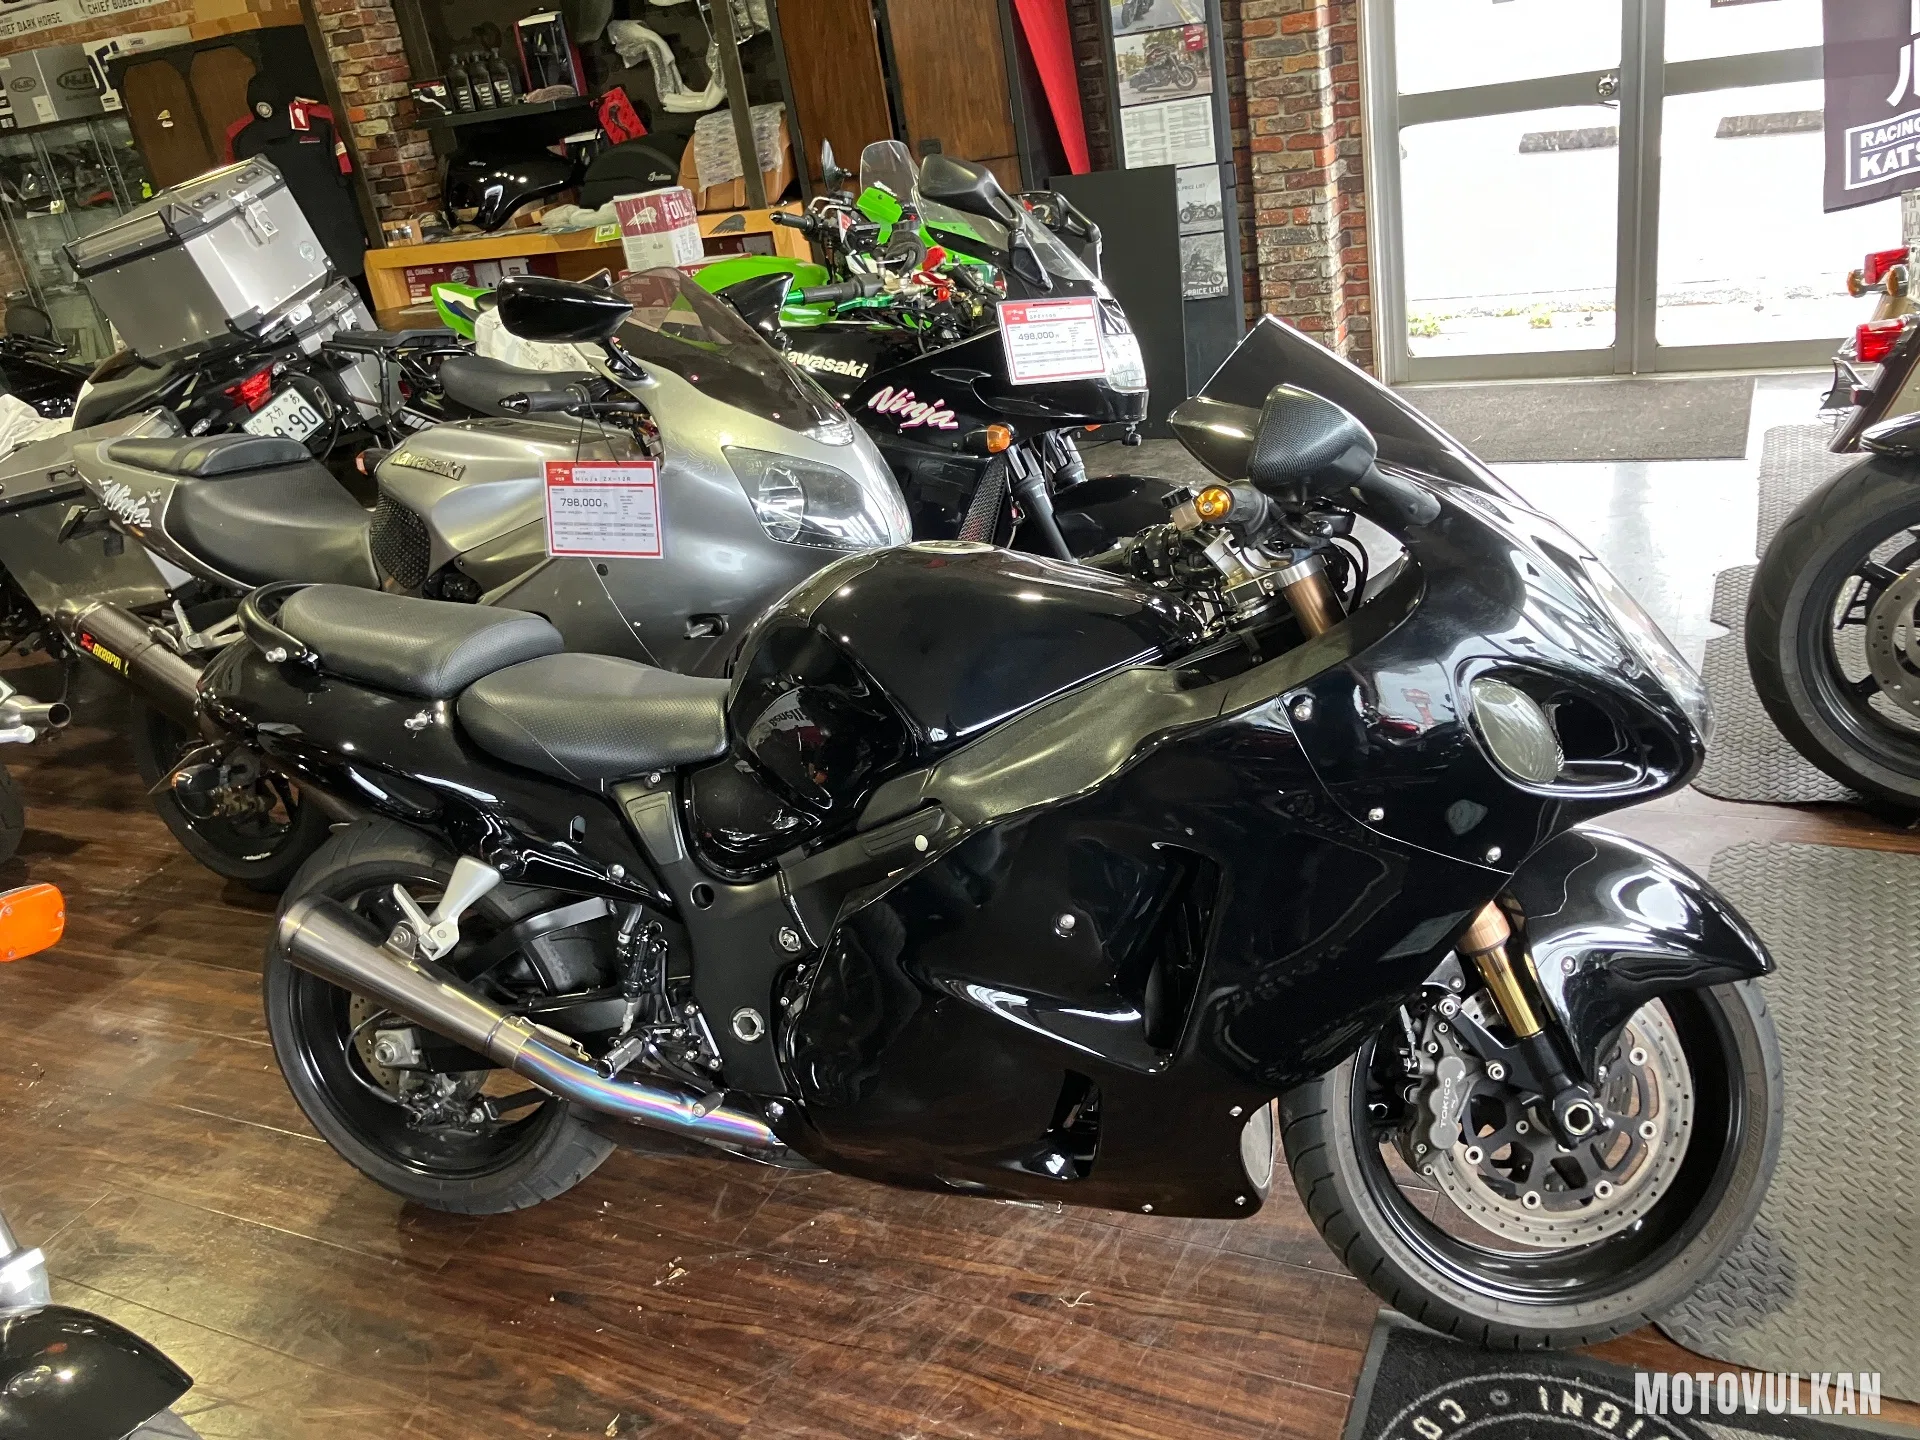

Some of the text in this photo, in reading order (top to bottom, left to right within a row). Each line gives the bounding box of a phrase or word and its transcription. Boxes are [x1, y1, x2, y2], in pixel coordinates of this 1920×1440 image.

[87, 1, 110, 15] CHIEF
[0, 12, 63, 36] HIEF DARK HORSE
[668, 199, 691, 220] OIL
[1187, 285, 1224, 296] PRICE LIST
[786, 351, 869, 379] awasaki
[868, 386, 959, 430] Ninja
[391, 450, 466, 481] Kawasaki
[1440, 1077, 1451, 1129] TOKICO
